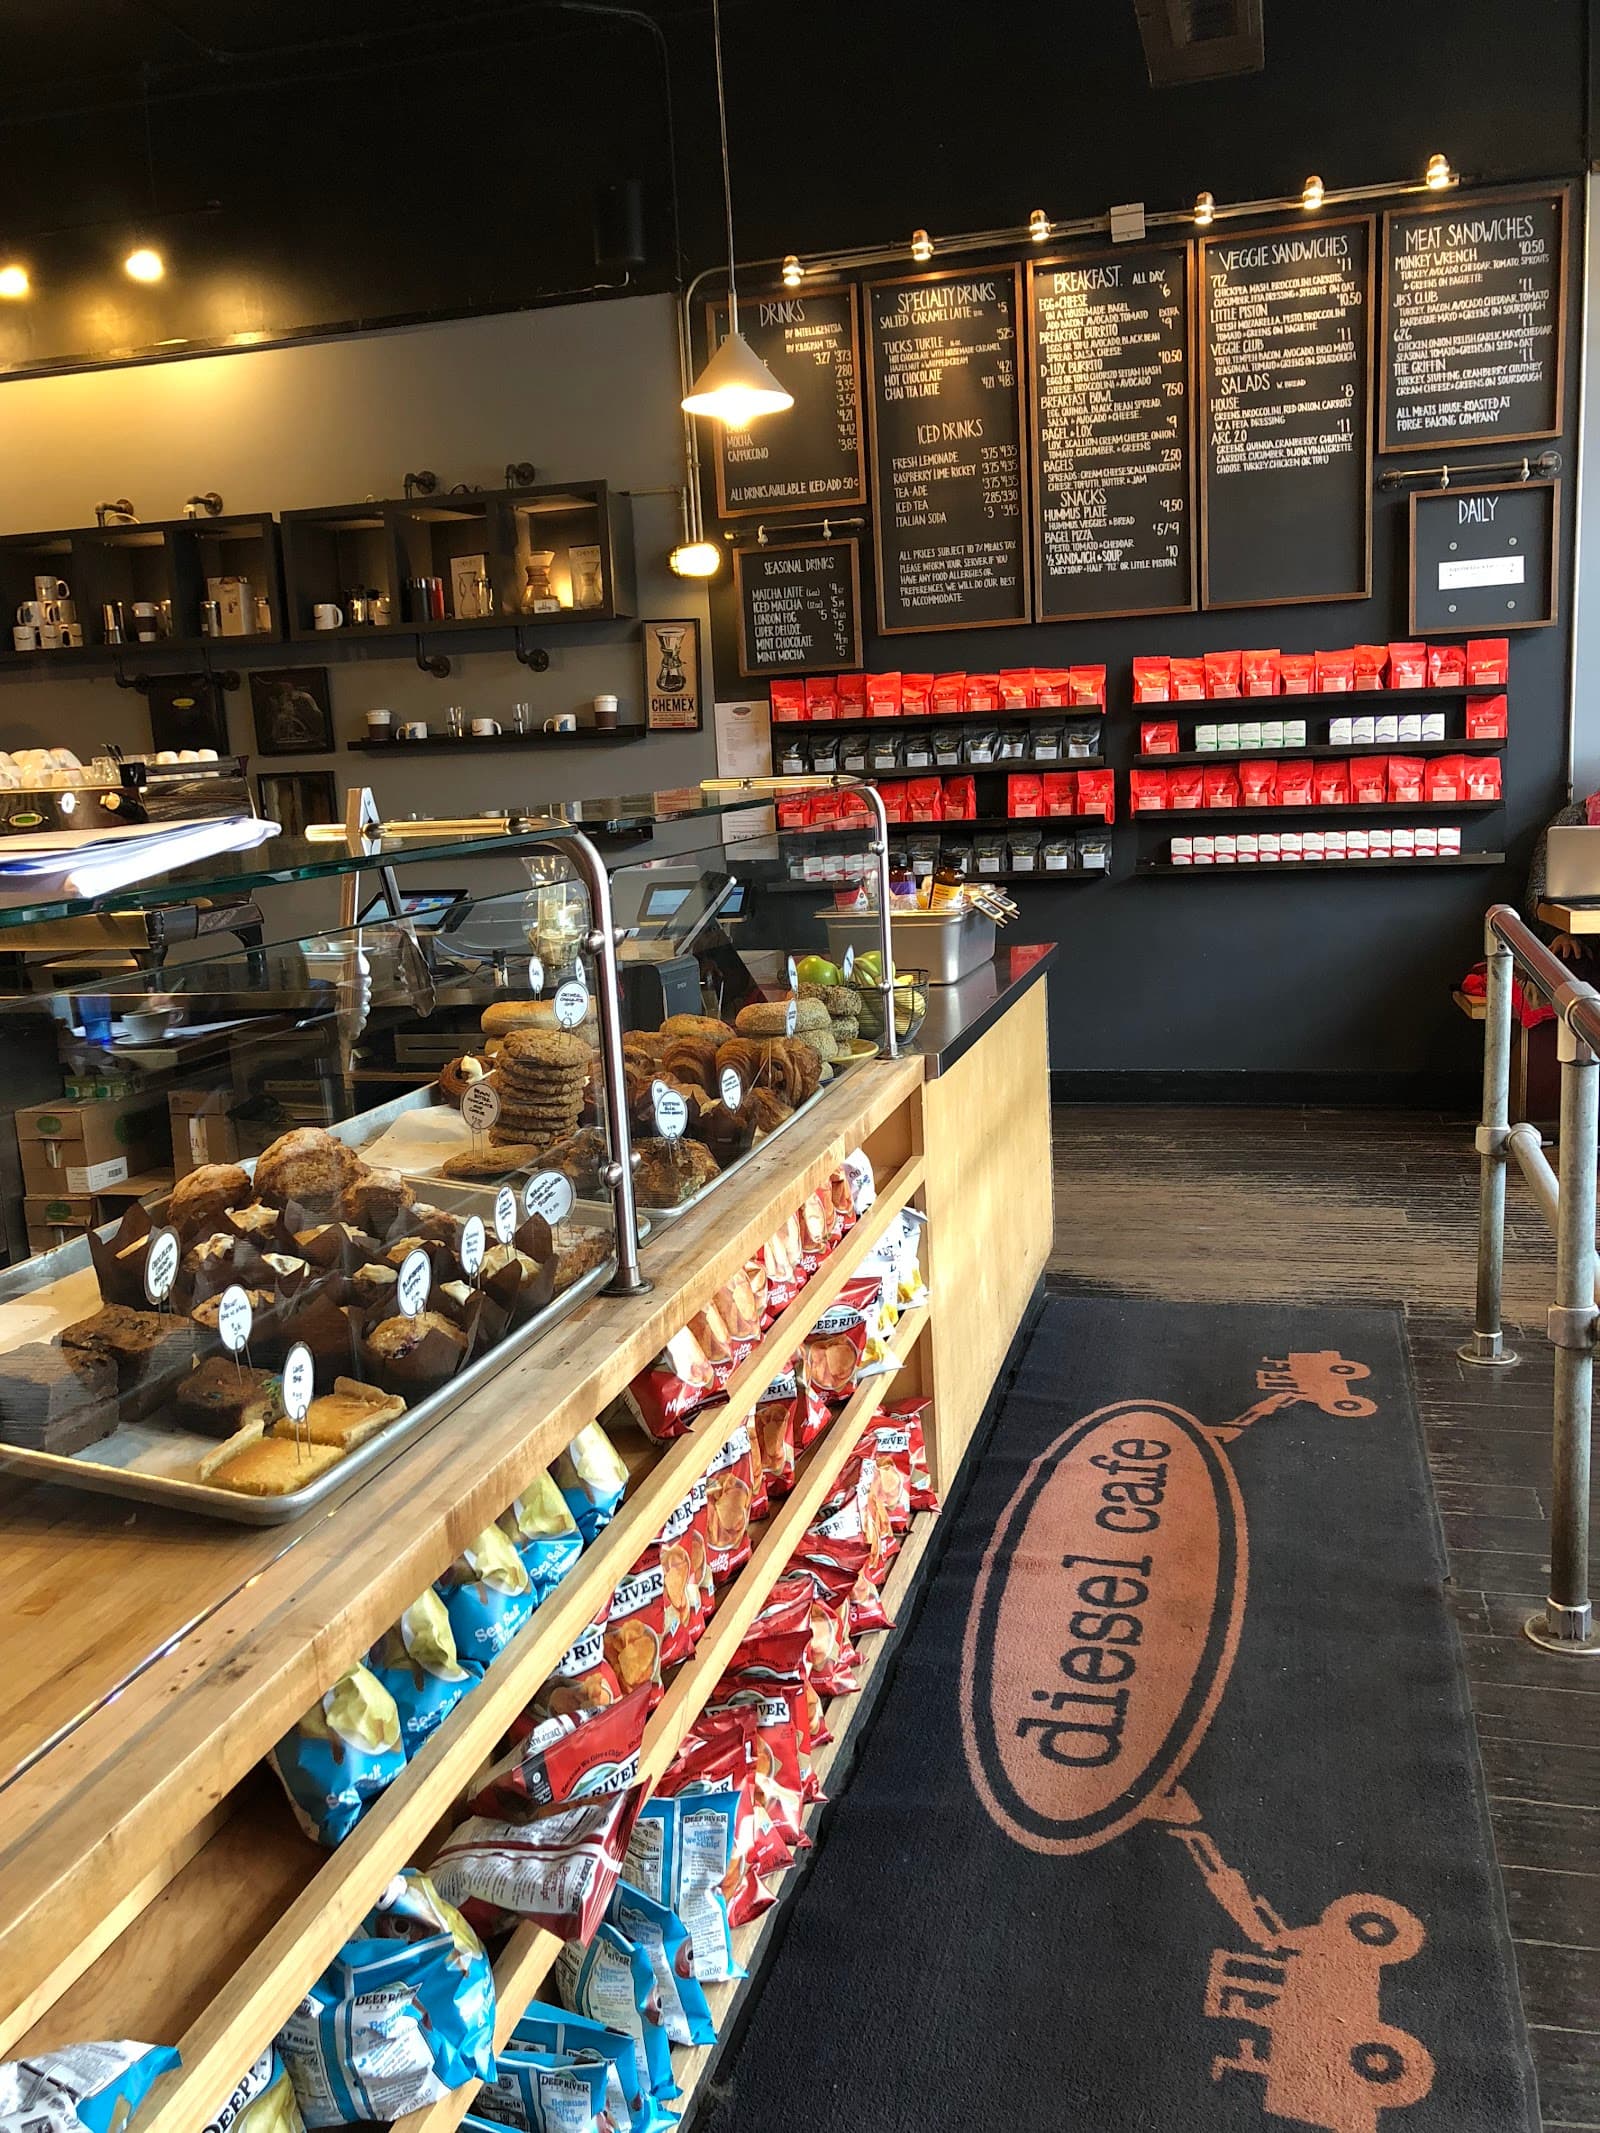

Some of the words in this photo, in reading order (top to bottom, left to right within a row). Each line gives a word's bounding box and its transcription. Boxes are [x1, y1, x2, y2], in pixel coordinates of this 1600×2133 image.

[1406, 226, 1442, 252] MEAT
[1446, 215, 1534, 246] SANDWICHES
[1219, 246, 1269, 271] VEGGIE
[1272, 236, 1348, 265] SANDWICHES
[1395, 254, 1432, 272] MONKEY
[1434, 248, 1478, 265] WRENCH
[1132, 272, 1147, 285] ALL
[1150, 270, 1166, 282] DAY
[1211, 274, 1228, 288] 712
[898, 287, 954, 314] SPECIALTY
[958, 282, 996, 304] DRINKS
[1414, 291, 1438, 304] CLUB
[760, 299, 805, 327] DRINKS
[880, 315, 908, 329] SALTED
[912, 309, 949, 324] CARAMEL
[950, 306, 971, 320] LATTE
[1210, 308, 1236, 323] LITTLE
[1239, 304, 1268, 320] PISTON
[784, 329, 793, 338] BY
[1039, 328, 1082, 344] BREAKFAST
[1084, 324, 1118, 338] BURRITO
[1394, 328, 1412, 342] 626
[826, 339, 838, 348] TEA
[883, 340, 912, 355] TUCKS
[914, 336, 943, 350] TURTLE
[1210, 340, 1240, 356] VEGGIE
[1243, 338, 1264, 351] CLUB
[1068, 358, 1103, 374] BURRITO
[1393, 363, 1409, 376] THE
[1412, 358, 1446, 375] GRIFFIN
[884, 374, 900, 386] HOT
[902, 368, 942, 384] CHOCOLATE
[1221, 372, 1270, 396] SALADS
[885, 388, 904, 400] CHAI
[906, 385, 918, 398] TEA
[920, 382, 940, 396] LATTE
[1041, 393, 1086, 410] BREAKFAST
[1089, 390, 1114, 404] BOWL
[1211, 398, 1240, 412] HOUSE
[1396, 408, 1411, 419] ALL
[1412, 404, 1436, 416] MEATS
[1500, 396, 1510, 408] AT
[1398, 419, 1423, 432] FORGE
[1425, 414, 1456, 429] BAKING
[1459, 410, 1500, 424] COMPANY
[726, 434, 754, 448] MOCHA
[917, 424, 940, 445] ICED
[942, 419, 984, 440] DRINKS
[1042, 428, 1070, 442] BAGEL
[1076, 424, 1092, 438] LOX
[1212, 432, 1232, 446] ARC
[728, 447, 768, 462] CAPPUCCINO
[892, 456, 917, 470] FRESH
[919, 451, 959, 466] LEMONADE
[893, 470, 932, 485] RASPBERRY
[934, 468, 950, 480] LIME
[951, 464, 976, 477] RICKEY
[1043, 458, 1074, 474] BAGELS
[730, 488, 743, 501] ALL
[744, 484, 768, 499] DRINKS
[769, 482, 806, 496] AVAILABLE
[809, 480, 826, 493] ICED
[826, 478, 841, 492] ADD
[1060, 488, 1107, 508] SNACKS
[896, 502, 912, 513] ICED
[914, 500, 928, 510] TEA
[1044, 508, 1080, 522] HUMMUS
[1084, 505, 1107, 520] PLATE
[1458, 496, 1499, 524] DAILY
[896, 514, 926, 528] ITALIAN
[928, 512, 947, 524] SODA
[1044, 531, 1070, 545] BAGEL
[1072, 528, 1093, 542] PIZZA
[899, 550, 912, 561] ALL
[913, 548, 935, 559] PRICES
[938, 545, 964, 556] SUBJECT
[967, 544, 974, 554] TO
[984, 542, 1003, 552] MEALS
[1055, 551, 1096, 566] SANDWICH
[1102, 549, 1123, 562] SOUP
[764, 558, 804, 576] SEASONAL
[806, 556, 834, 571] DRINKS
[900, 562, 921, 574] PLEASE
[923, 560, 944, 570] INFORM
[946, 559, 962, 568] YOUR
[964, 556, 988, 568] SERVER
[996, 554, 1008, 564] YOU
[900, 574, 918, 584] HAVE
[918, 573, 932, 583] ANY
[932, 572, 948, 581] FOOD
[949, 568, 982, 580] ALLERGIES
[945, 582, 956, 591] WE
[958, 580, 974, 590] WILL
[974, 580, 982, 588] DO
[984, 578, 998, 587] OUR
[1000, 576, 1016, 586] BEST
[752, 587, 782, 601] MATCHA
[784, 586, 804, 599] LATTE
[901, 598, 910, 607] TO
[753, 601, 770, 614] ICED
[771, 598, 803, 612] MATCHA
[754, 613, 782, 626] LONDON
[784, 612, 797, 623] FOG
[754, 626, 774, 638] CIDER
[775, 624, 802, 636] DELUXE
[756, 638, 774, 650] MINT
[776, 635, 814, 650] CHOCOLATE
[756, 651, 777, 664] MINT
[778, 649, 806, 661] MOCHA
[652, 698, 694, 712] CHEMEX
[813, 1320, 838, 1330] EEP
[530, 1560, 550, 1580] Sea
[613, 1573, 663, 1606] RIVER
[1016, 1553, 1153, 1769] diesel
[1089, 1436, 1172, 1536] cafe
[474, 1623, 500, 1643] Sea
[355, 1994, 386, 2006] DEEP
[542, 2076, 564, 2086] DEEP
